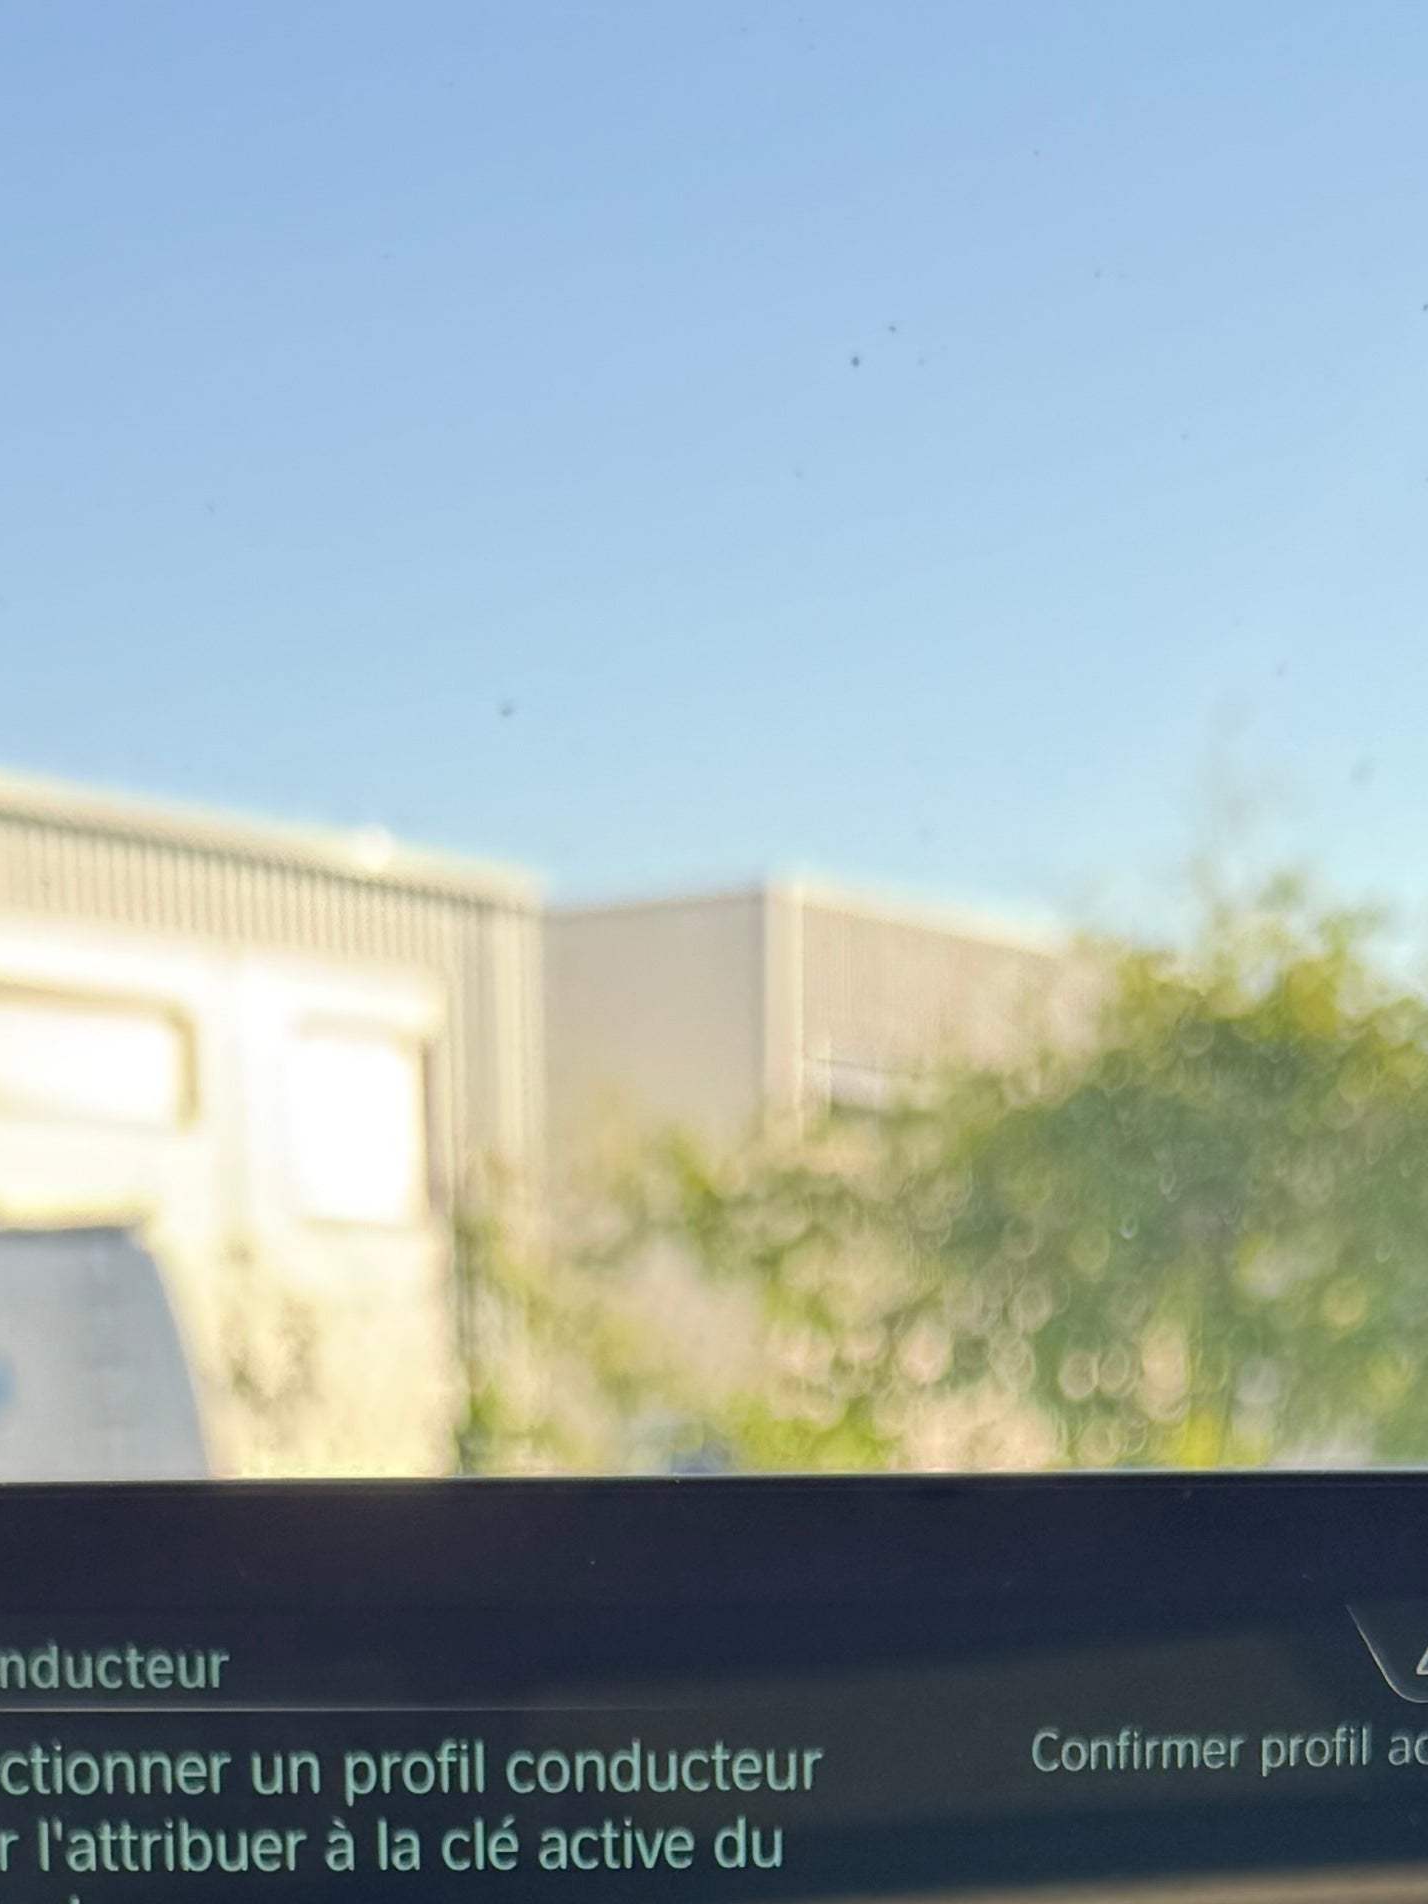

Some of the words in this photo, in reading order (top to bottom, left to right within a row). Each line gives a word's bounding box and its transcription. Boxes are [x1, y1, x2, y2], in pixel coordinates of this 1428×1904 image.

[251, 1752, 321, 1795] un
[344, 1740, 485, 1807] profil
[506, 1740, 823, 1794] conducteur
[1031, 1728, 1244, 1772] Confirmer
[1261, 1725, 1370, 1777] profil
[38, 1820, 307, 1873] l'attribuer
[325, 1818, 355, 1872] à
[377, 1819, 421, 1871] la
[441, 1816, 519, 1871] clé
[538, 1819, 695, 1870] active
[714, 1816, 783, 1869] du
